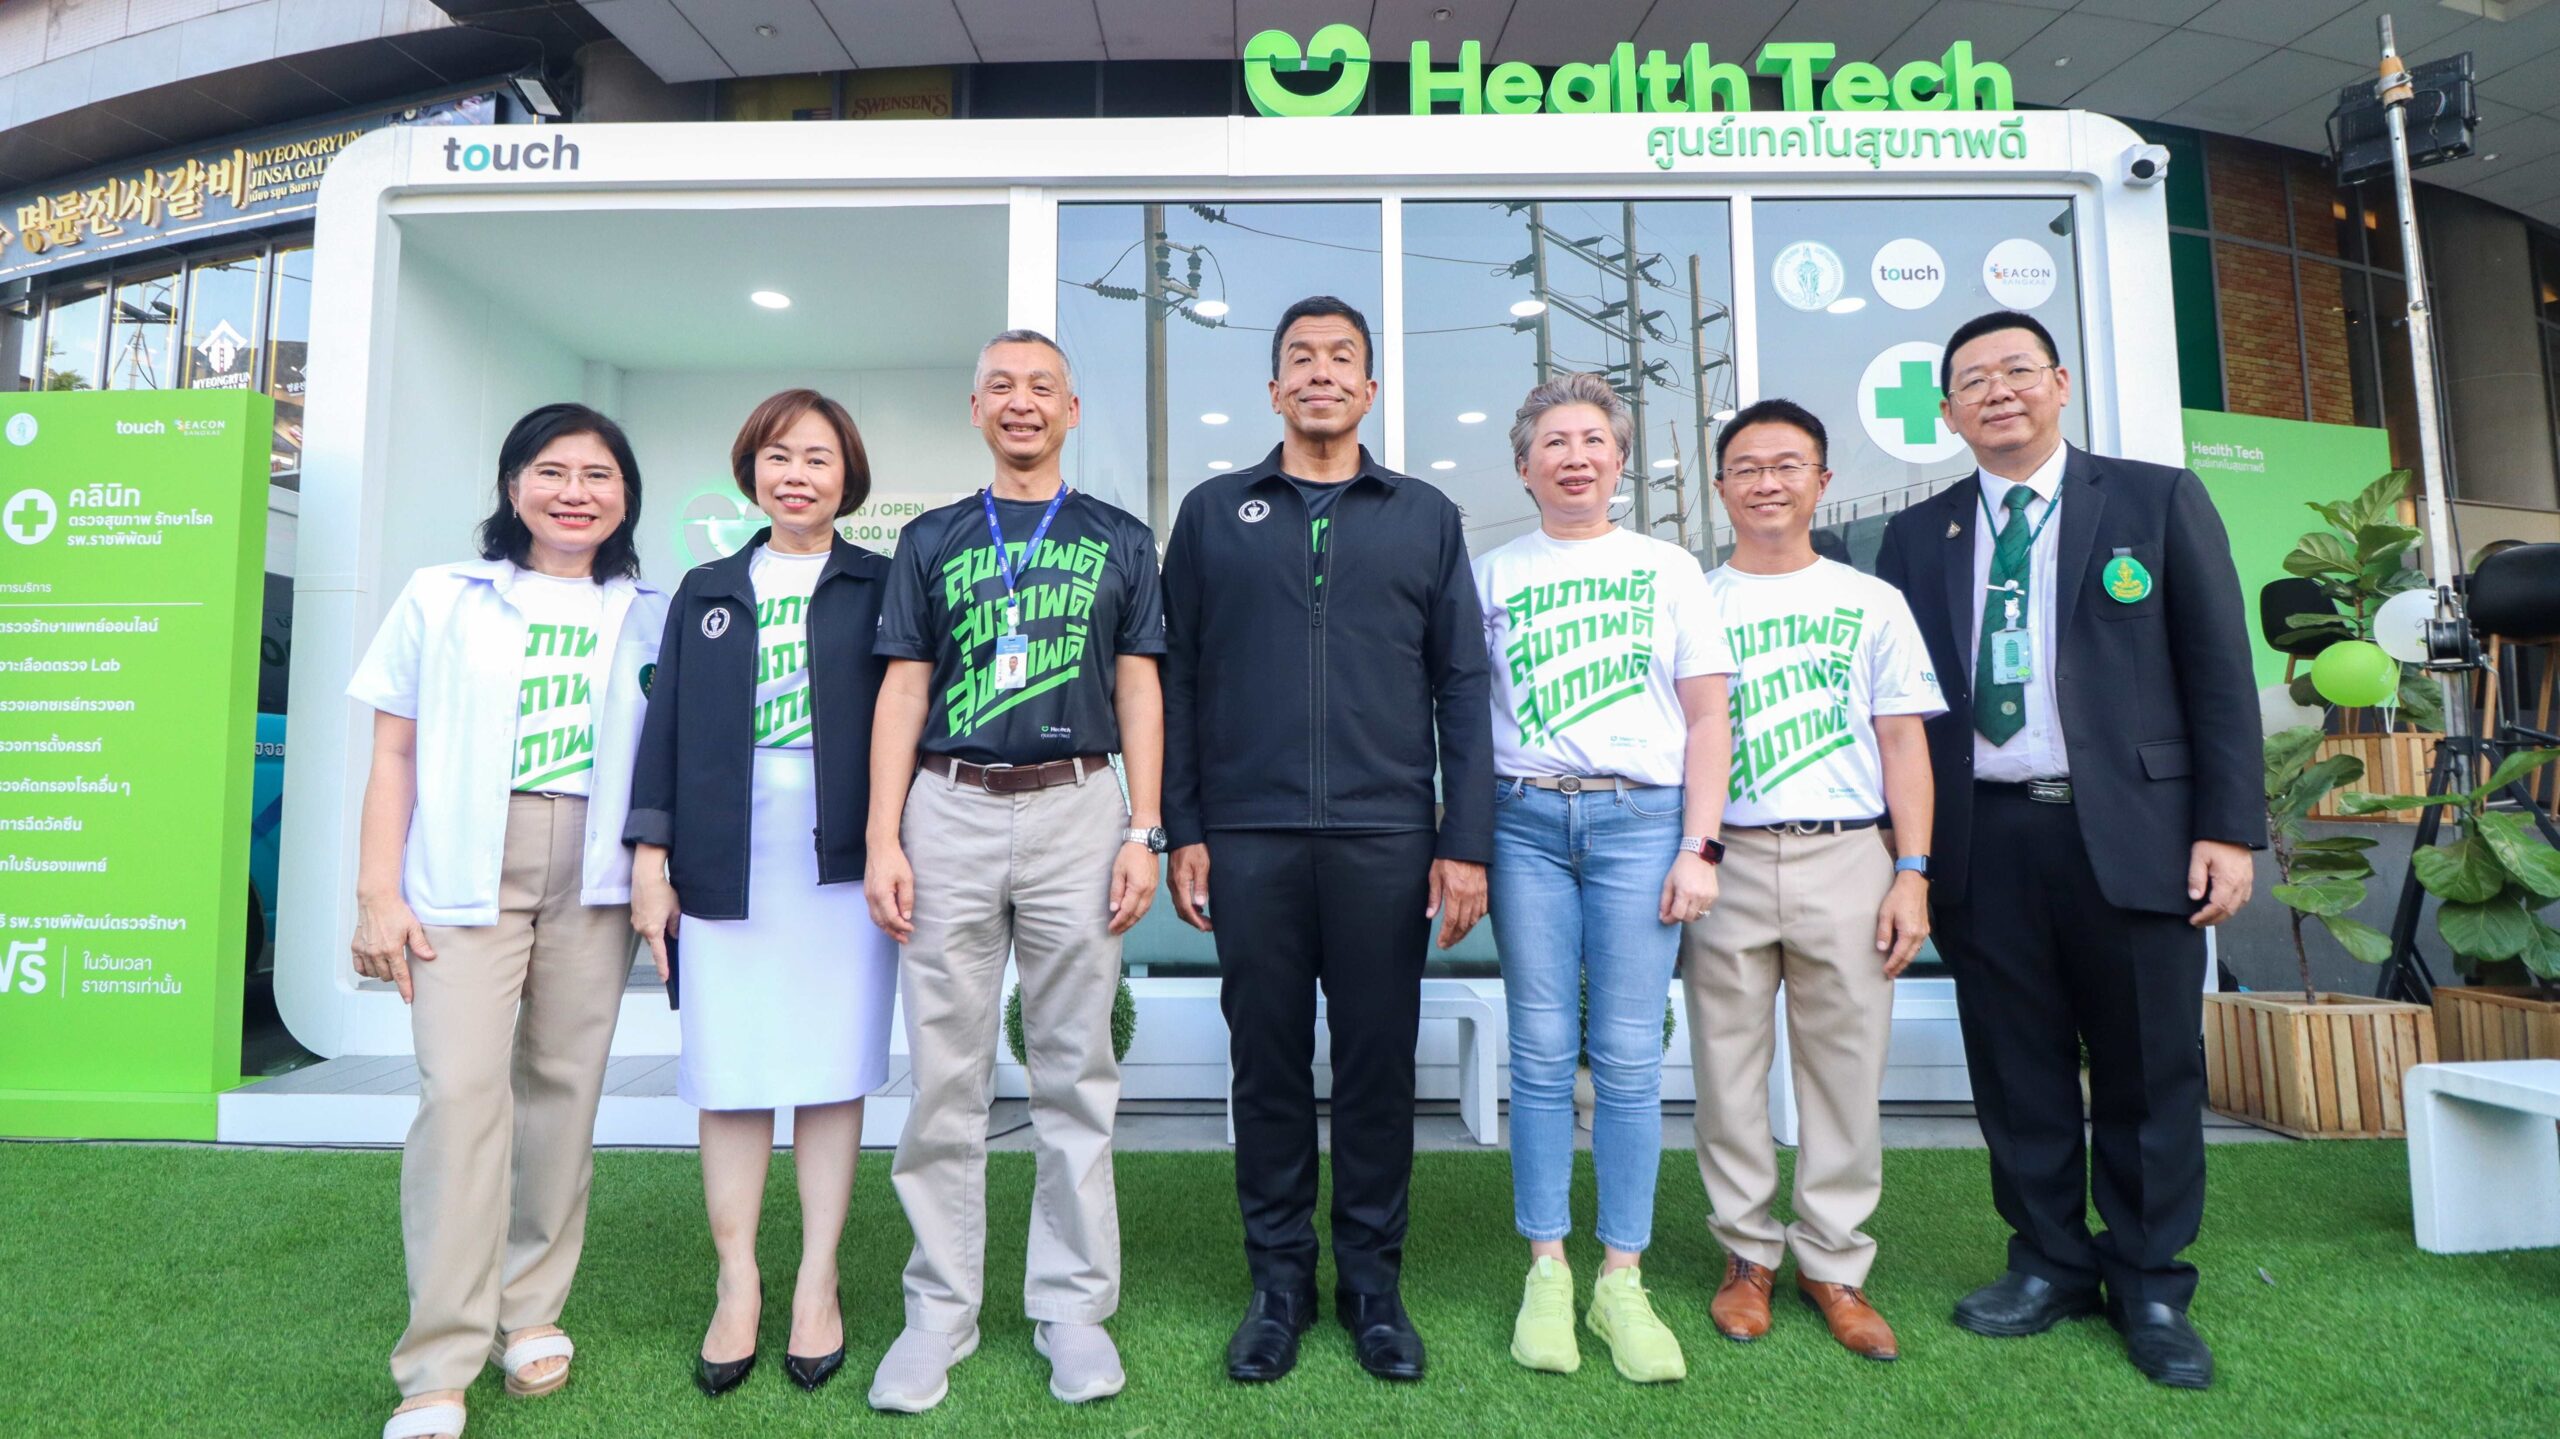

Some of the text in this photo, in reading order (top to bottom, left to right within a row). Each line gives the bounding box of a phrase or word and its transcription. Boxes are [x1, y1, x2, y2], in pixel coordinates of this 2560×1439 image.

[1409, 40, 2014, 115] Health Tech
[443, 134, 580, 172] touch
[1647, 116, 2028, 170] ศูนย์เทคโนสุขภาพดี
[249, 164, 293, 190] JINSA
[1880, 265, 1939, 281] touch
[115, 420, 165, 434] touch
[2192, 441, 2264, 460] Health Tech
[69, 483, 140, 508] คลินิก
[69, 508, 213, 530] ตรวจสุขภาพ รักษาโรค
[881, 503, 924, 517] OPEN
[67, 530, 162, 547] รพ.ราชพิพัฒน์
[1505, 569, 1657, 632] สุขภาพดี
[1505, 605, 1655, 687] สุขภาพดี
[91, 658, 120, 671] Lab
[1516, 642, 1653, 749] สุขภาพดี
[83, 950, 152, 971] ในวันเวลา
[82, 973, 182, 994] ราชการเท่านั้น
